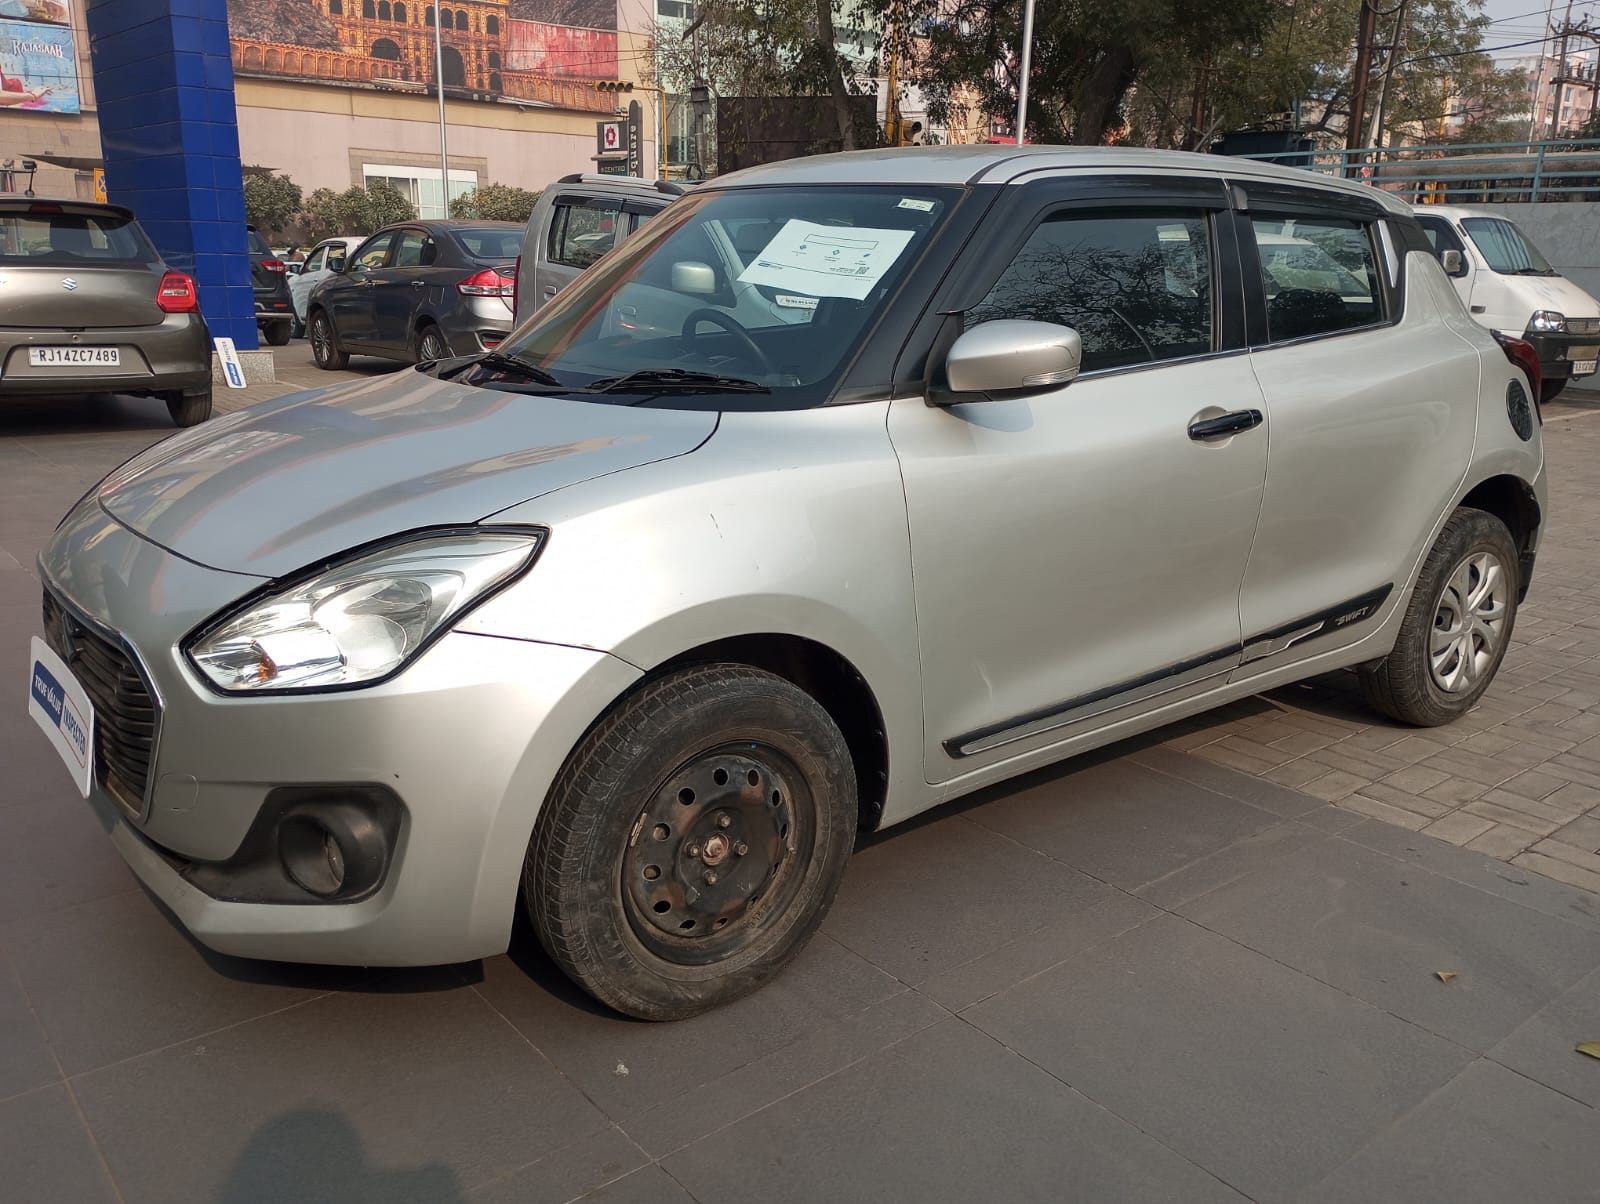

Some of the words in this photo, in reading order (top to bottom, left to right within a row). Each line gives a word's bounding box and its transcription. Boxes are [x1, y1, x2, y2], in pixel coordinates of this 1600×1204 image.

[11, 39, 63, 58] RAJASAAB
[630, 126, 638, 178] square
[39, 349, 118, 362] RJ14ZC7489
[1335, 606, 1369, 626] SWIFT
[35, 675, 47, 697] TRUE
[48, 687, 62, 715] VALUE
[64, 705, 85, 755] INSPECTED
